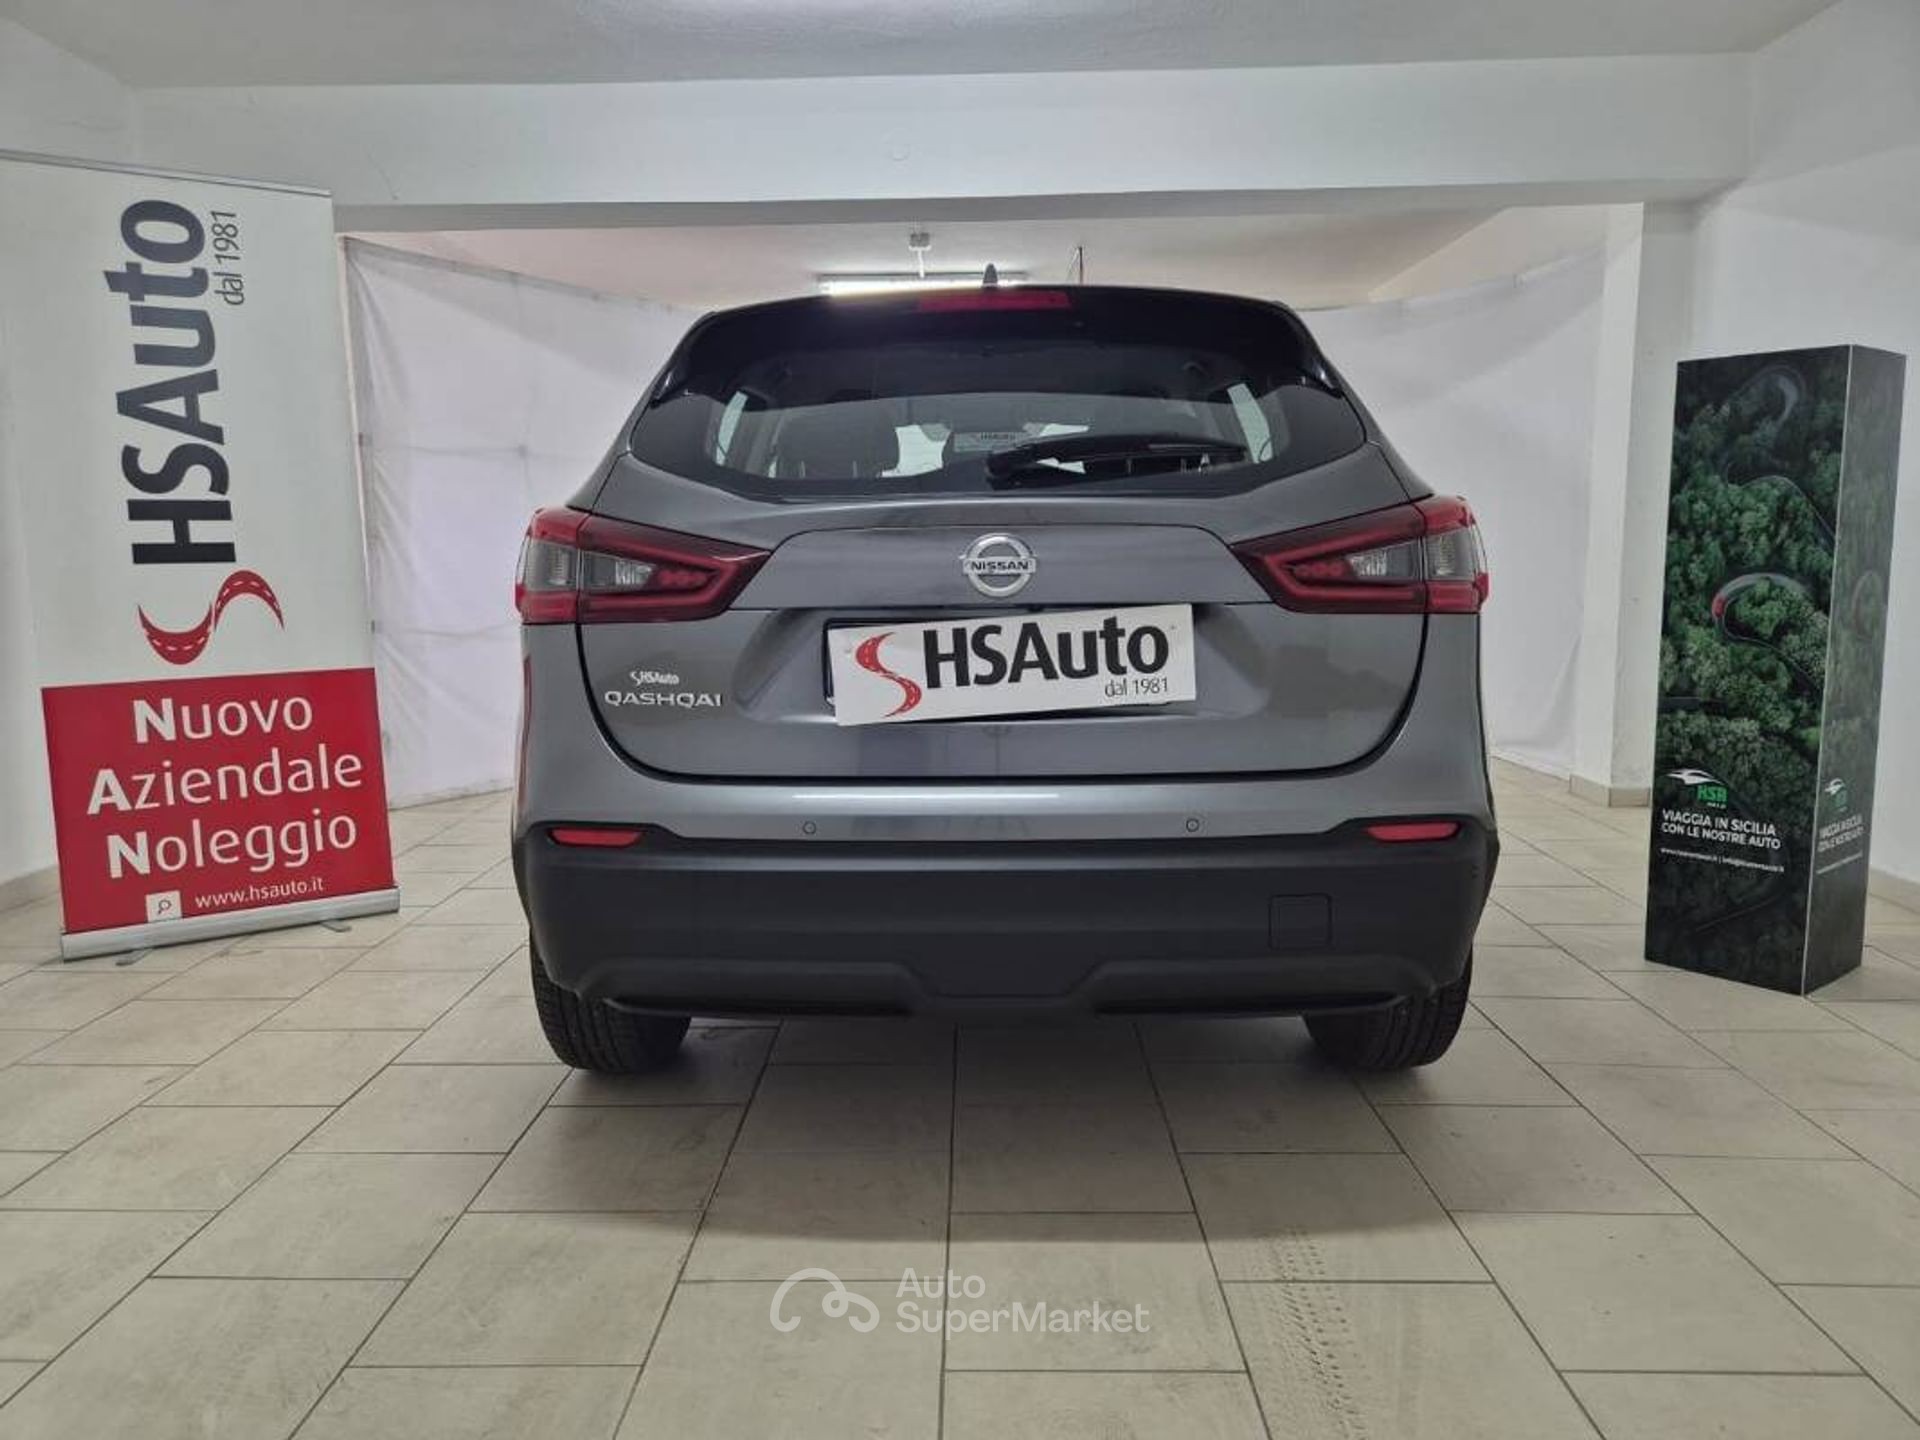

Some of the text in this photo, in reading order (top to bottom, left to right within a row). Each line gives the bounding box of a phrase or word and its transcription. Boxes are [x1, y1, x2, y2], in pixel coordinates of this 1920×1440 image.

[210, 210, 245, 305] dal 1981
[103, 199, 236, 565] HSAuto
[970, 560, 1030, 572] NISSAN
[922, 615, 1169, 689] HSAuto
[604, 690, 722, 709] QASHQAI
[1104, 677, 1169, 698] dal 1981
[132, 696, 313, 744] Nuovo
[86, 743, 362, 815] Aziendale
[1661, 821, 1781, 850] CON LE NOSTRE AUTO
[1662, 808, 1777, 837] VIAGGIA IN SICILIA
[106, 807, 357, 879] Noleggio
[194, 877, 324, 908] www.hsauto.it
